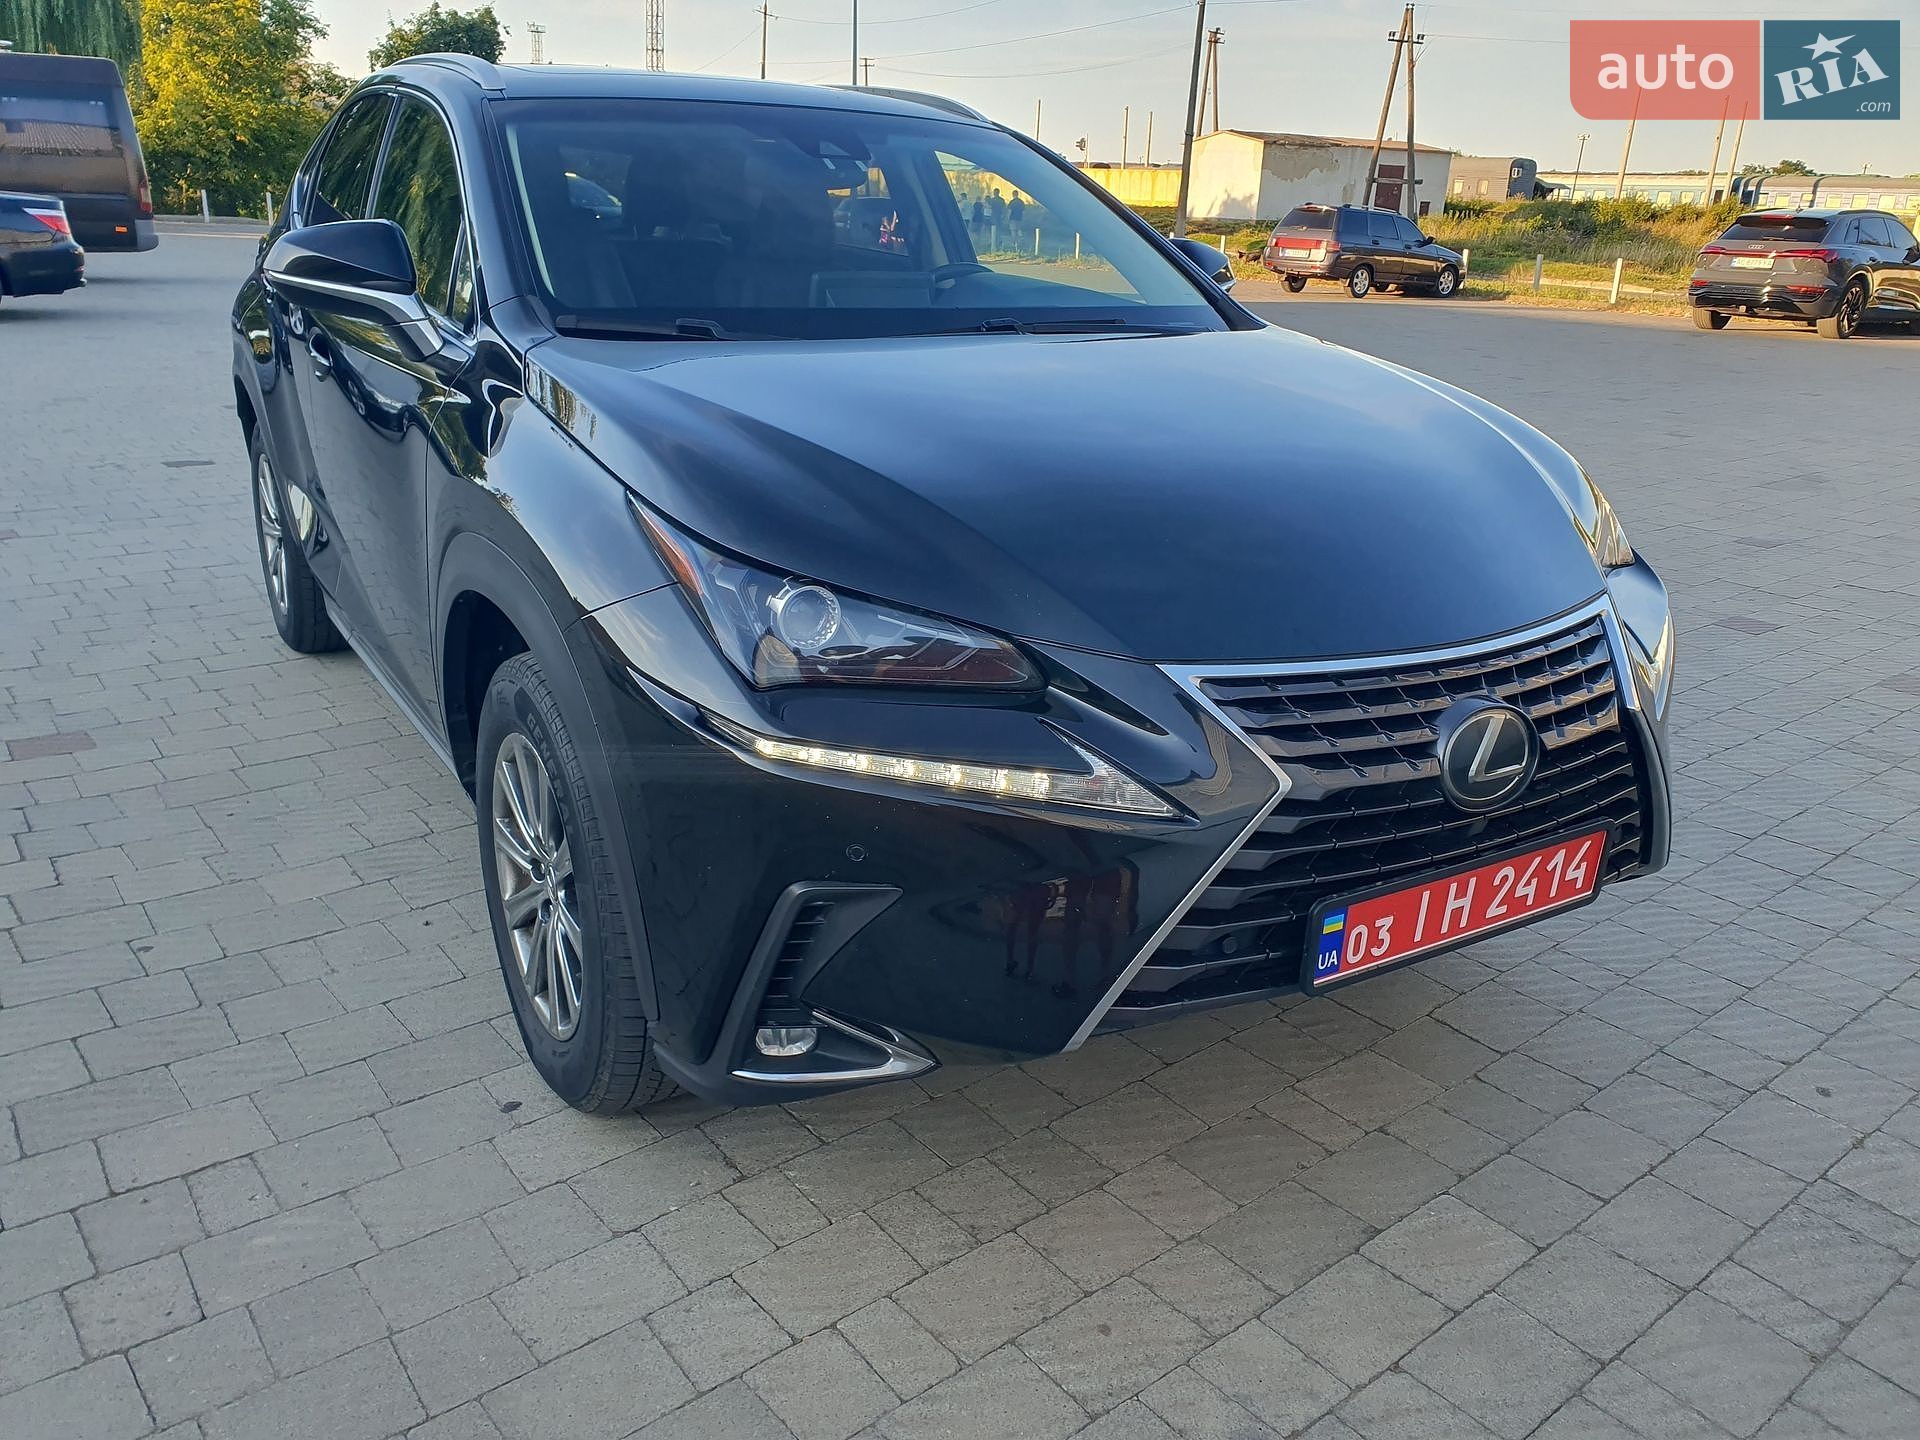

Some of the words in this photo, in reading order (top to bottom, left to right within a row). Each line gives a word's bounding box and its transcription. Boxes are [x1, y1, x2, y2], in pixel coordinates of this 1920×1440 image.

[1346, 915, 1394, 964] 03
[1413, 876, 1477, 943] IH
[1485, 839, 1592, 919] 2414
[1317, 949, 1338, 971] UA
